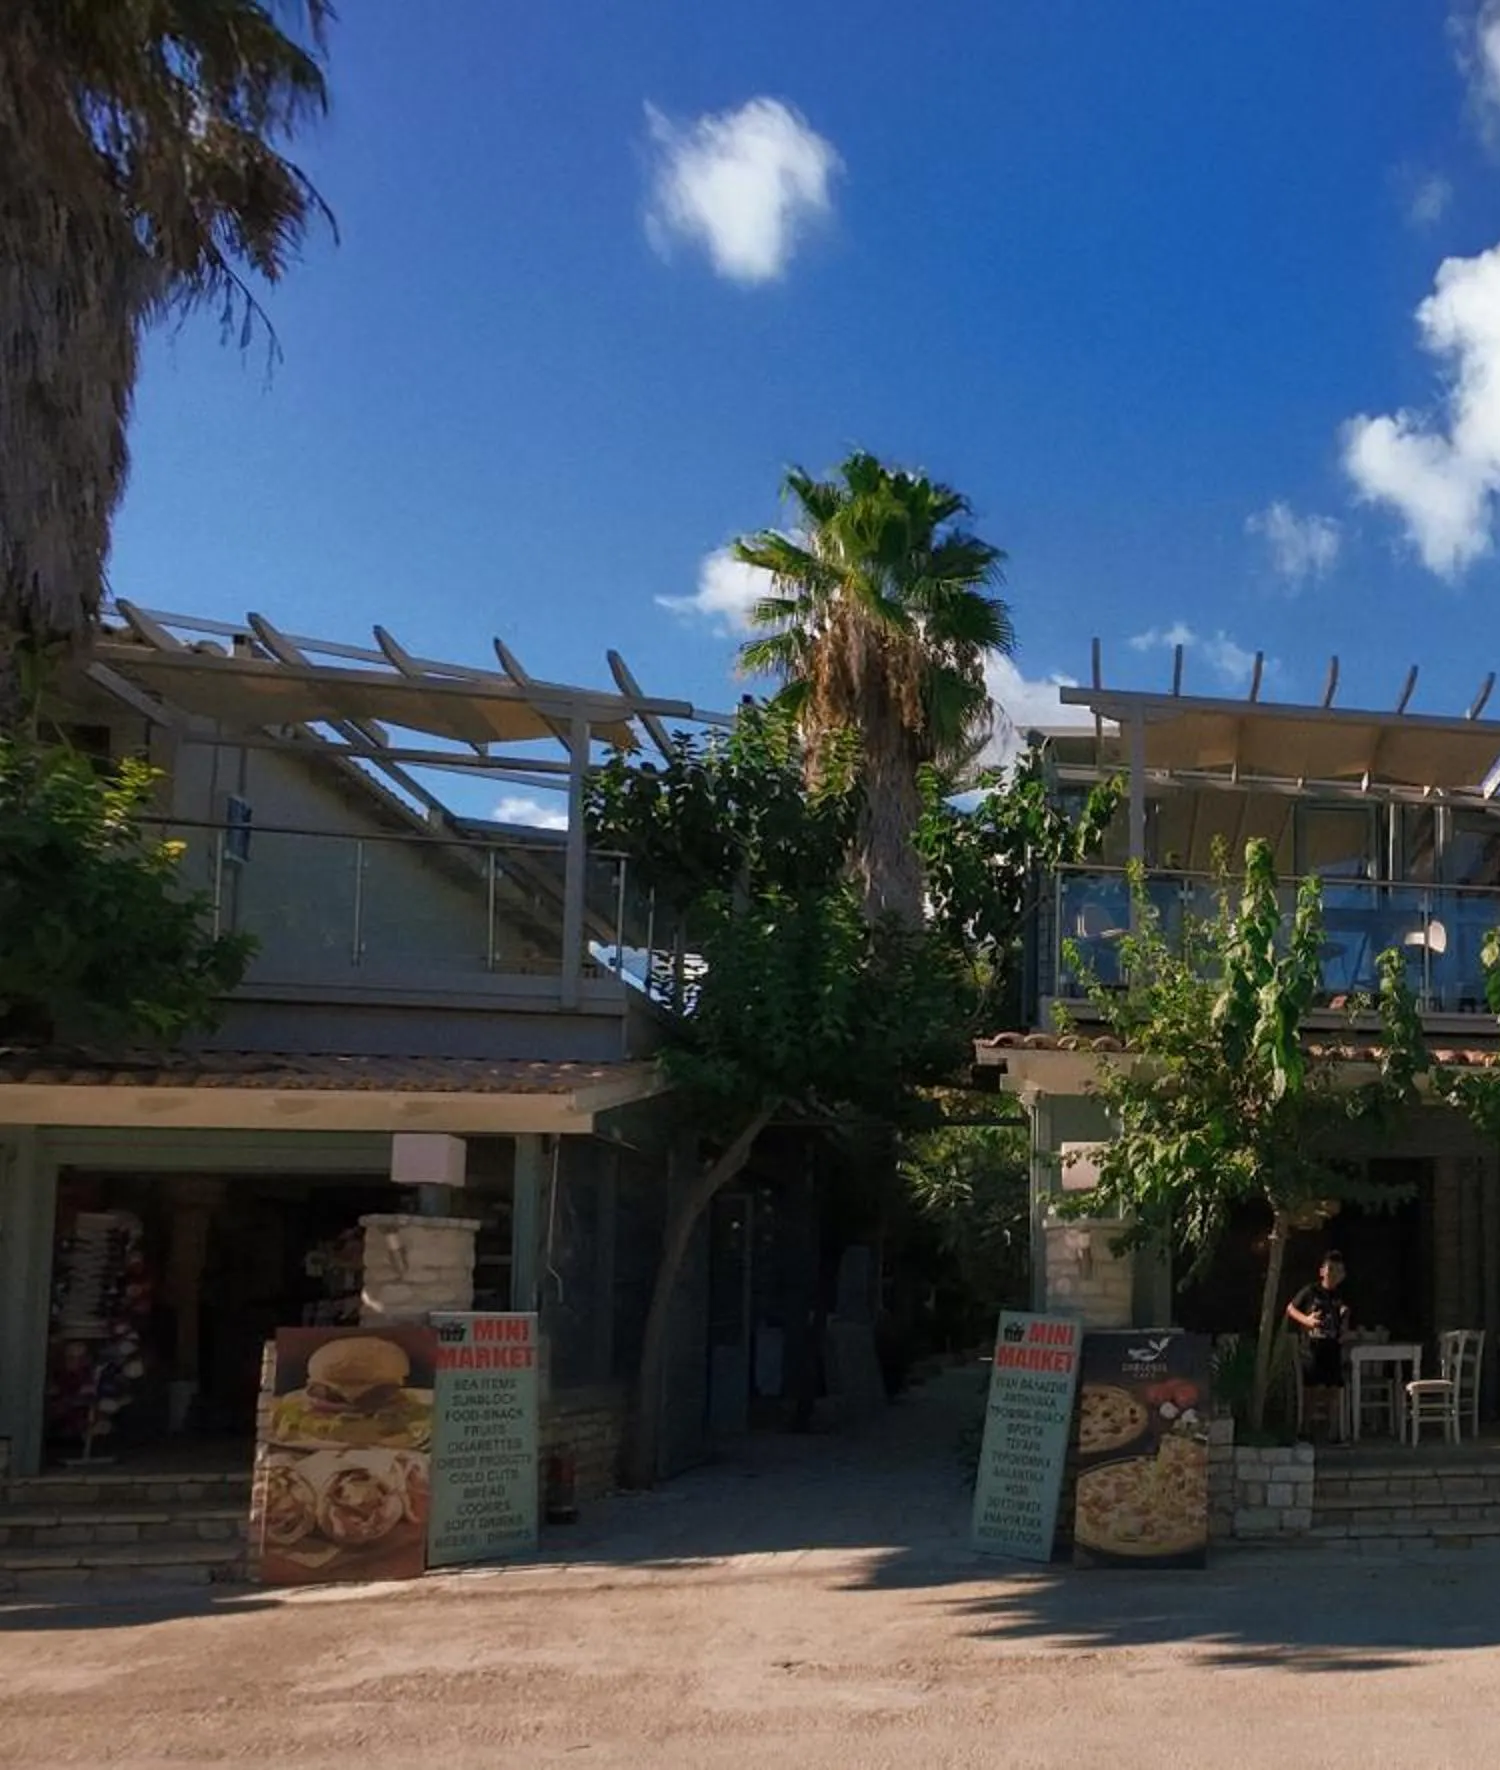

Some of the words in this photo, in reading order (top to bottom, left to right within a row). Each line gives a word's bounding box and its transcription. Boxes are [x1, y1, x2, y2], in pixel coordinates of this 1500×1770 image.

[474, 1319, 529, 1341] MINI
[1028, 1321, 1075, 1346] MINI
[437, 1347, 532, 1369] MARKET
[996, 1346, 1076, 1373] MARKET
